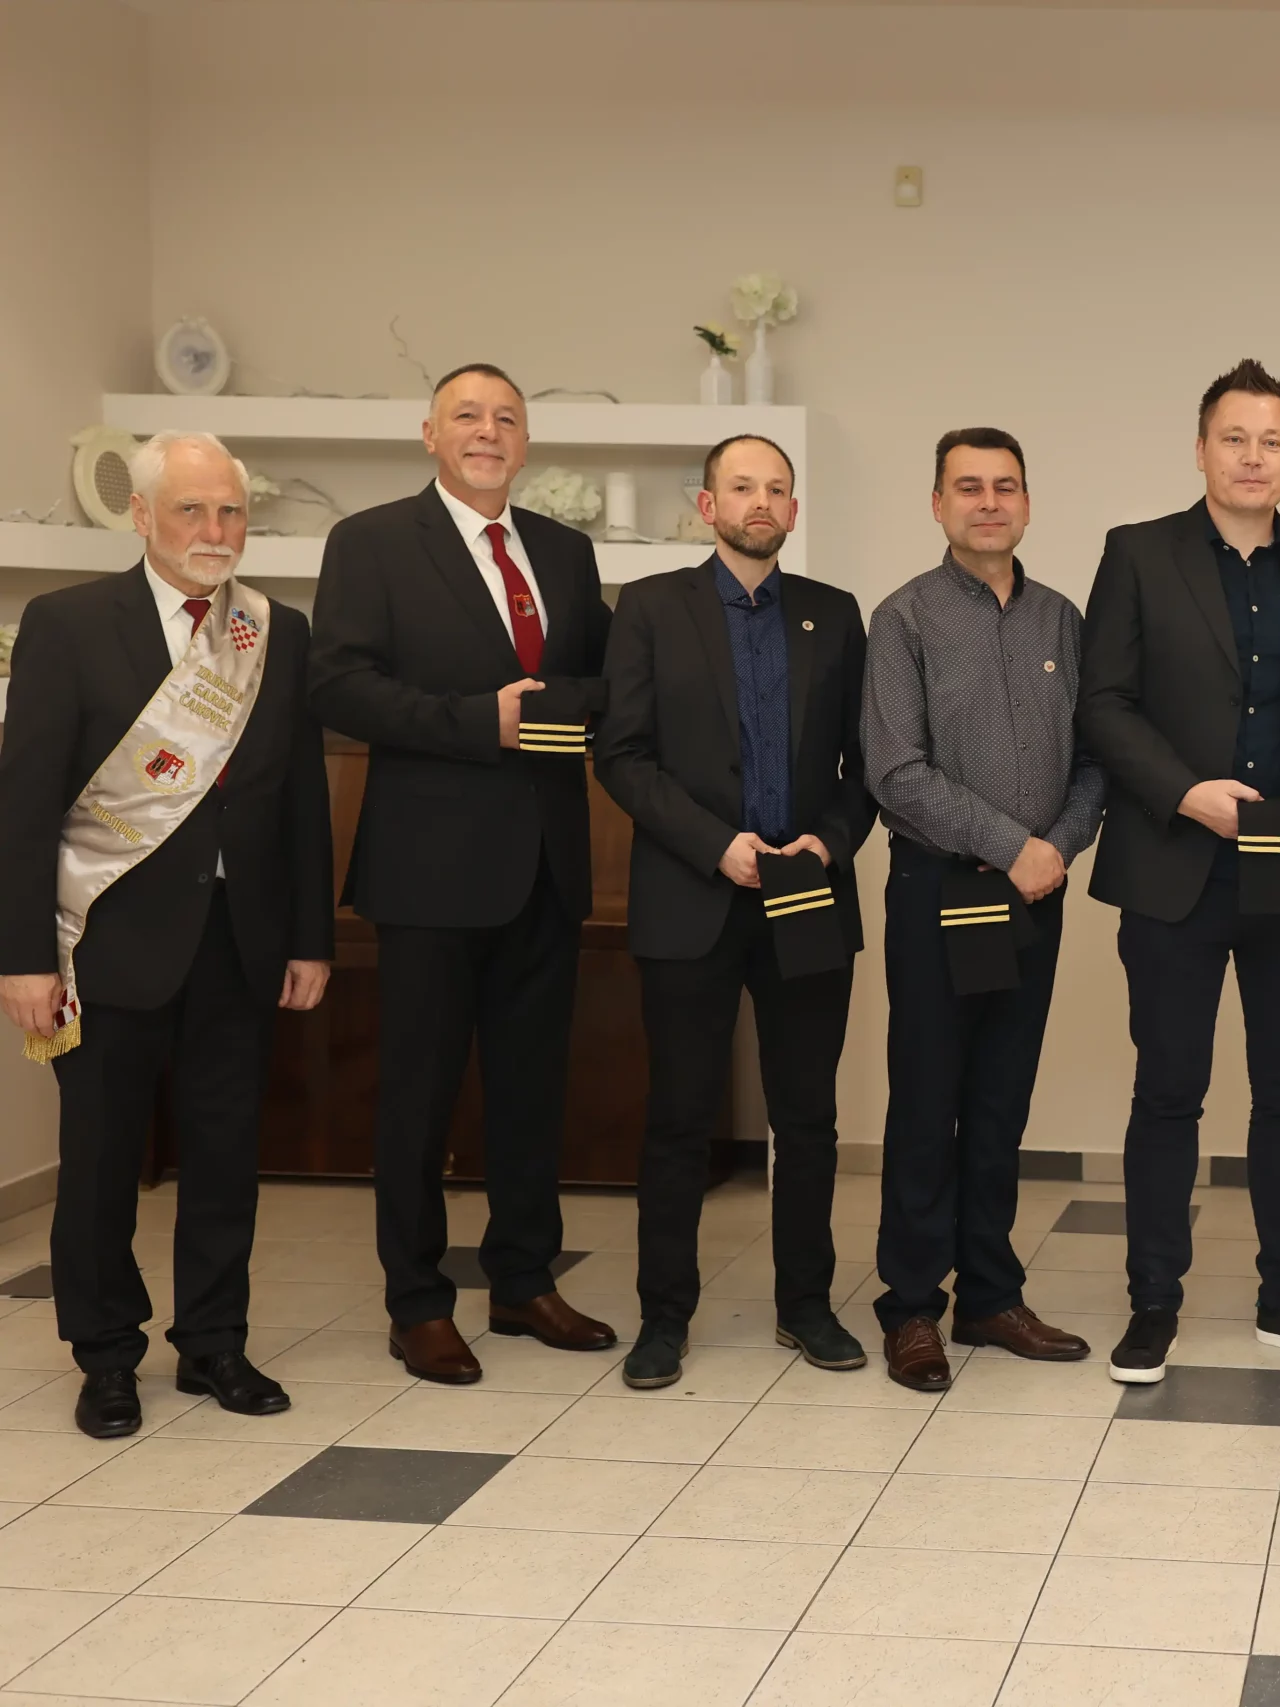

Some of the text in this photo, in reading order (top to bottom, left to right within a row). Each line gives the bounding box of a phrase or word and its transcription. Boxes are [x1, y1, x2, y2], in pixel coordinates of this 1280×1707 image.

[193, 683, 233, 716] GARDA
[195, 665, 244, 705] ZRINSKA
[179, 691, 232, 732] ČAKOVEC
[90, 800, 143, 845] PREDSJEDNIK
